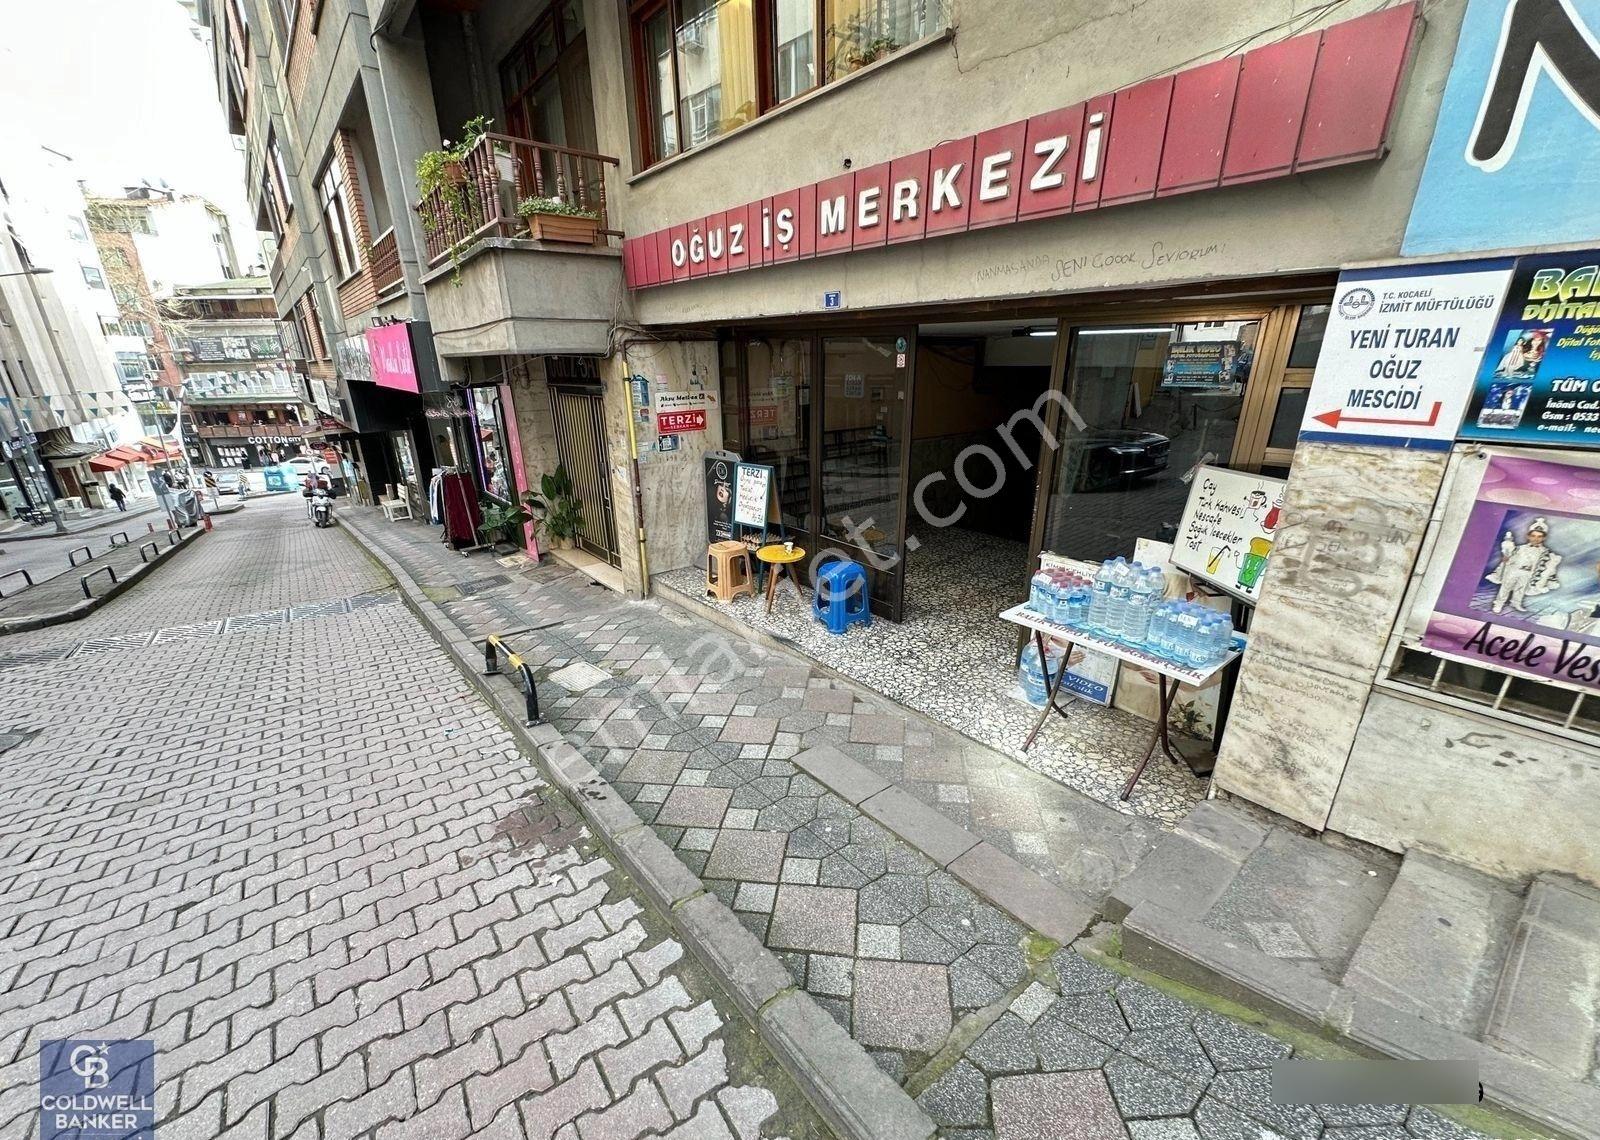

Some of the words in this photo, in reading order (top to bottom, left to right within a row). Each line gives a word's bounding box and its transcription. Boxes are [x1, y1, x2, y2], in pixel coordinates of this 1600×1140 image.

[671, 222, 745, 268] OĞUZ
[761, 207, 794, 252] İŞ
[820, 112, 1105, 236] MERKEZİ
[1378, 300, 1416, 313] İZMİT
[1417, 294, 1495, 312] MÜFTÜLÜĞÜ
[1398, 288, 1432, 299] KOCAELİ
[1350, 324, 1391, 349] YENİ
[1394, 327, 1460, 348] TURAN
[1369, 354, 1422, 379] OĞUZ
[1552, 377, 1588, 392] TÜM
[1346, 385, 1424, 410] MESCİDİ
[1542, 411, 1565, 420] Gsm
[1572, 411, 1600, 422] 0533
[248, 436, 288, 444] COTTON
[1463, 621, 1547, 668] Acele
